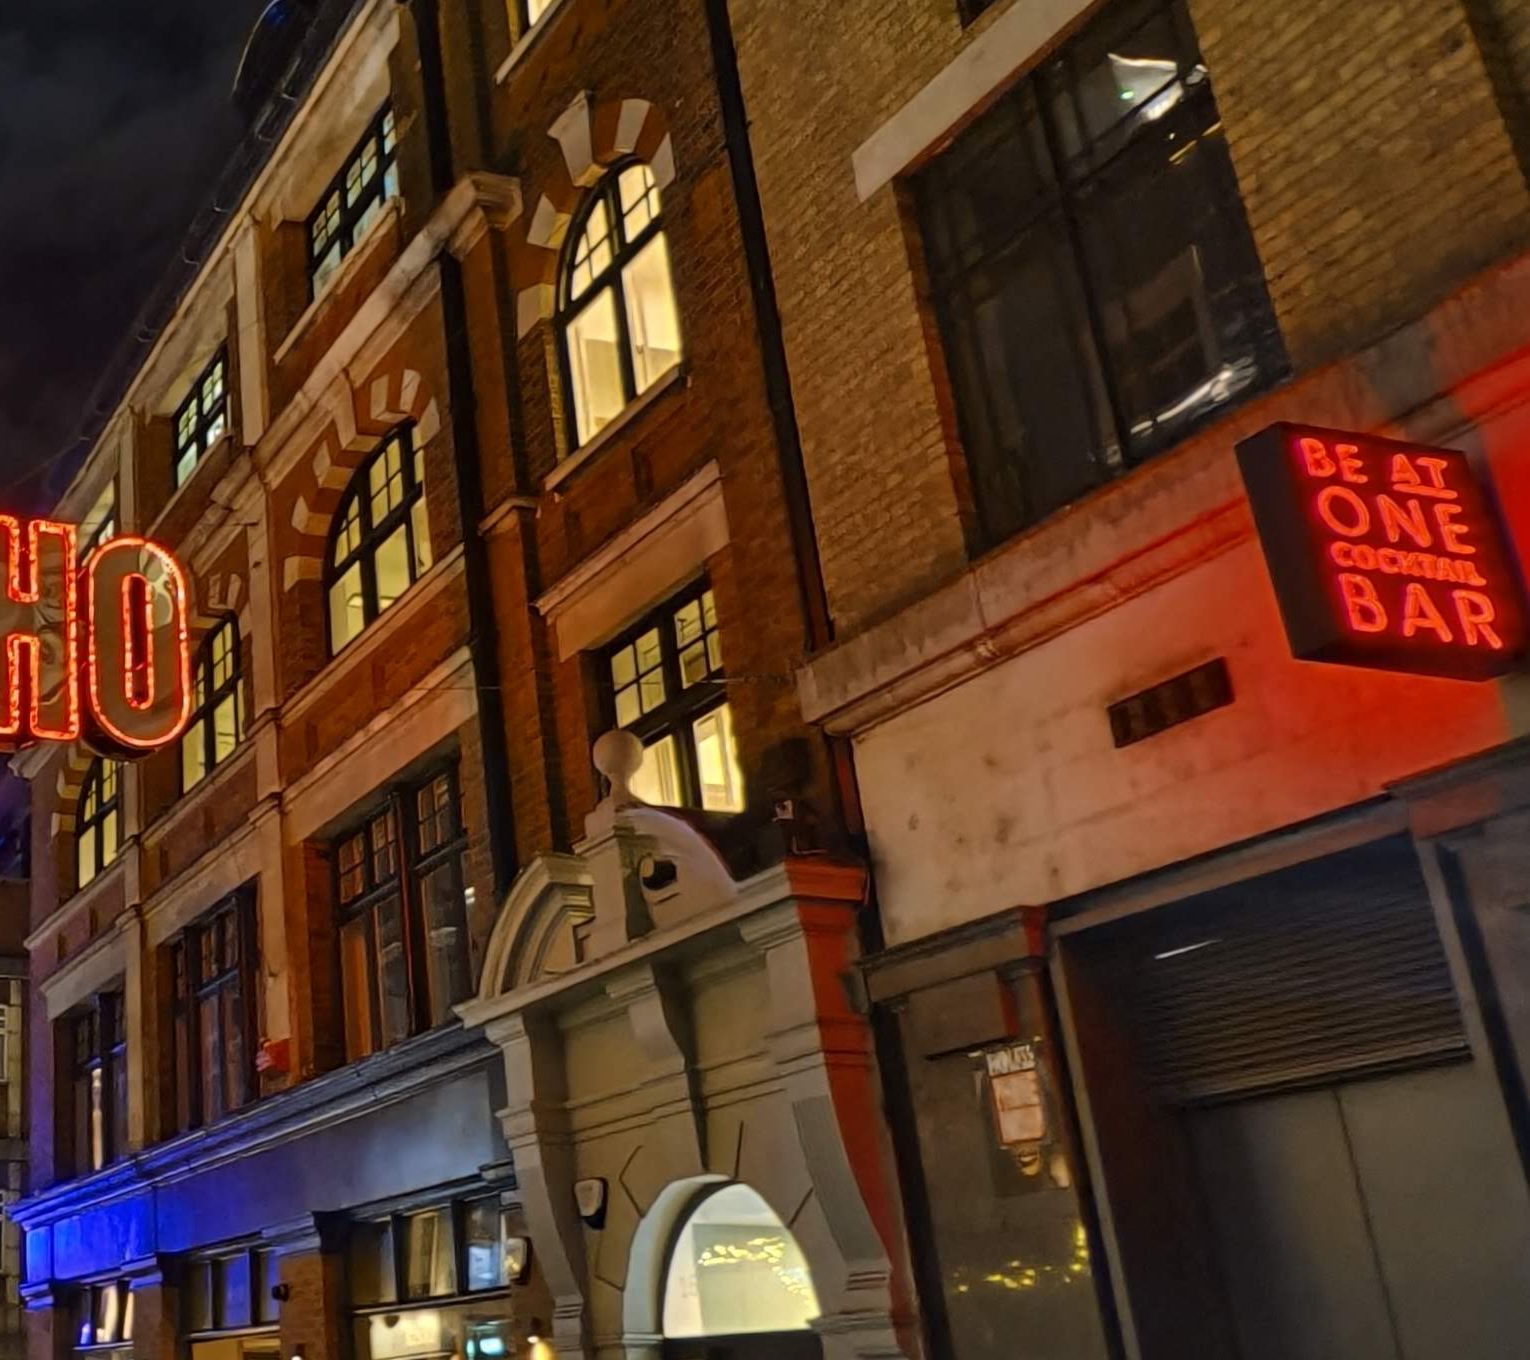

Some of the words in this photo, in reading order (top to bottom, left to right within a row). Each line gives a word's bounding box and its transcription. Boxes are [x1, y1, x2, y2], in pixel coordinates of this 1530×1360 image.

[1300, 437, 1368, 484] BE
[1391, 454, 1449, 490] AT
[1317, 486, 1476, 554] ONE
[1330, 541, 1487, 586] COCKTAIL
[1338, 573, 1503, 649] BAR
